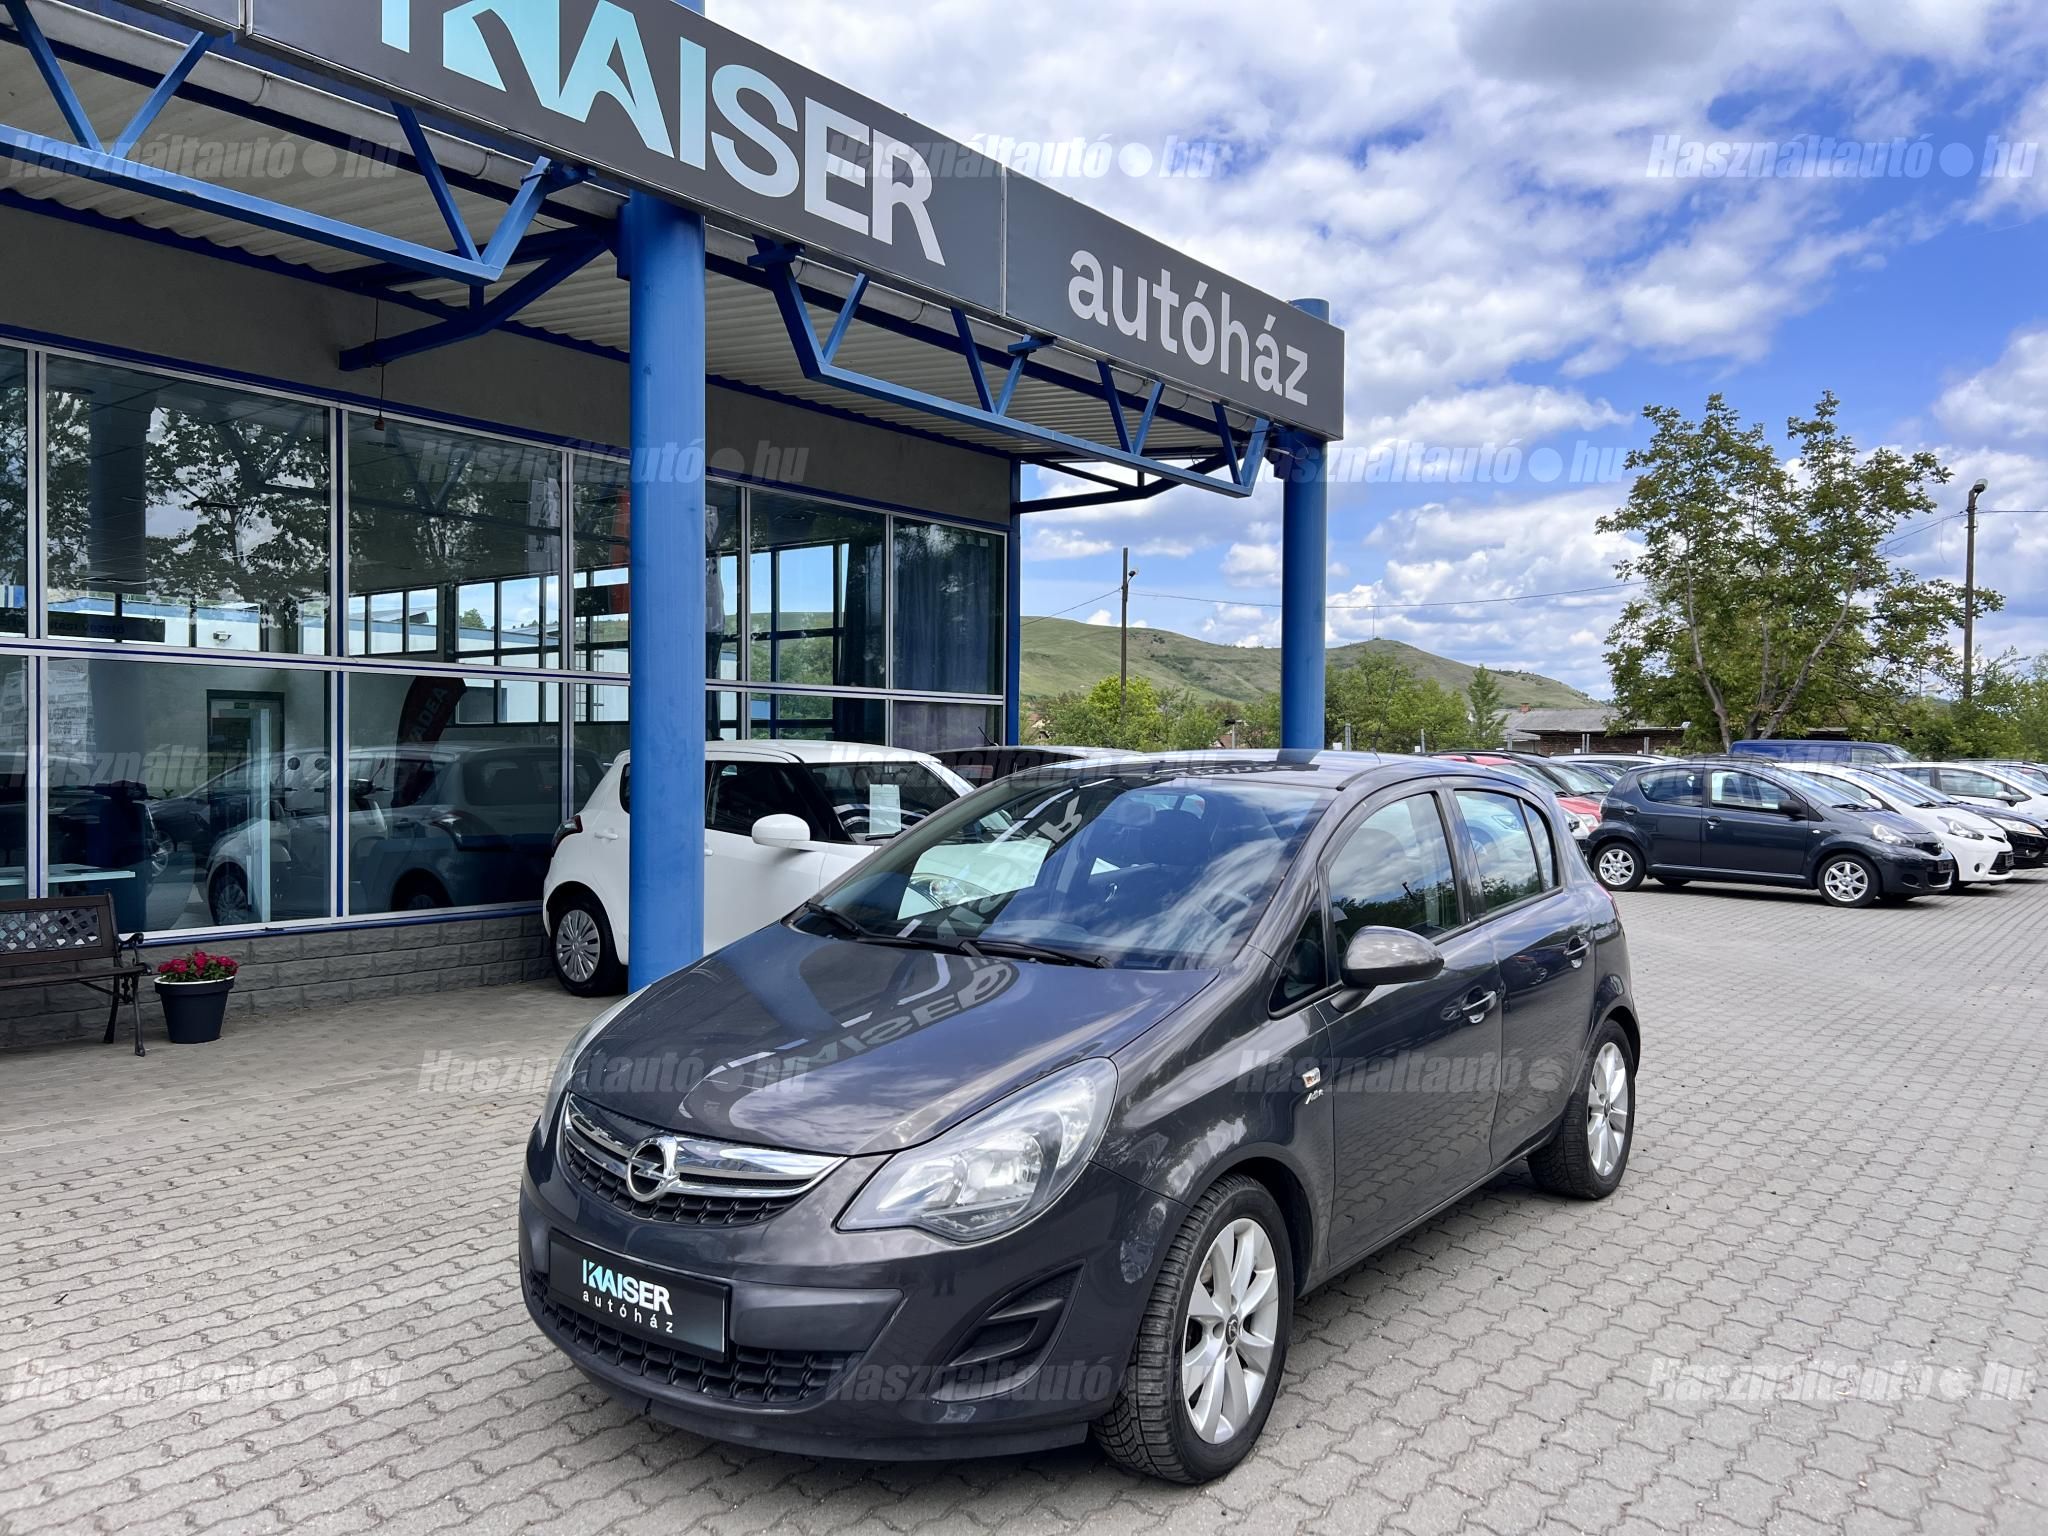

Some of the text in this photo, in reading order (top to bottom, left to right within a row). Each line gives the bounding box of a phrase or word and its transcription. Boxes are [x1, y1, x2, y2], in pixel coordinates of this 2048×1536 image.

[1068, 250, 1309, 406] autóház
[582, 1258, 674, 1316] KAISER
[582, 1290, 674, 1334] autóház
